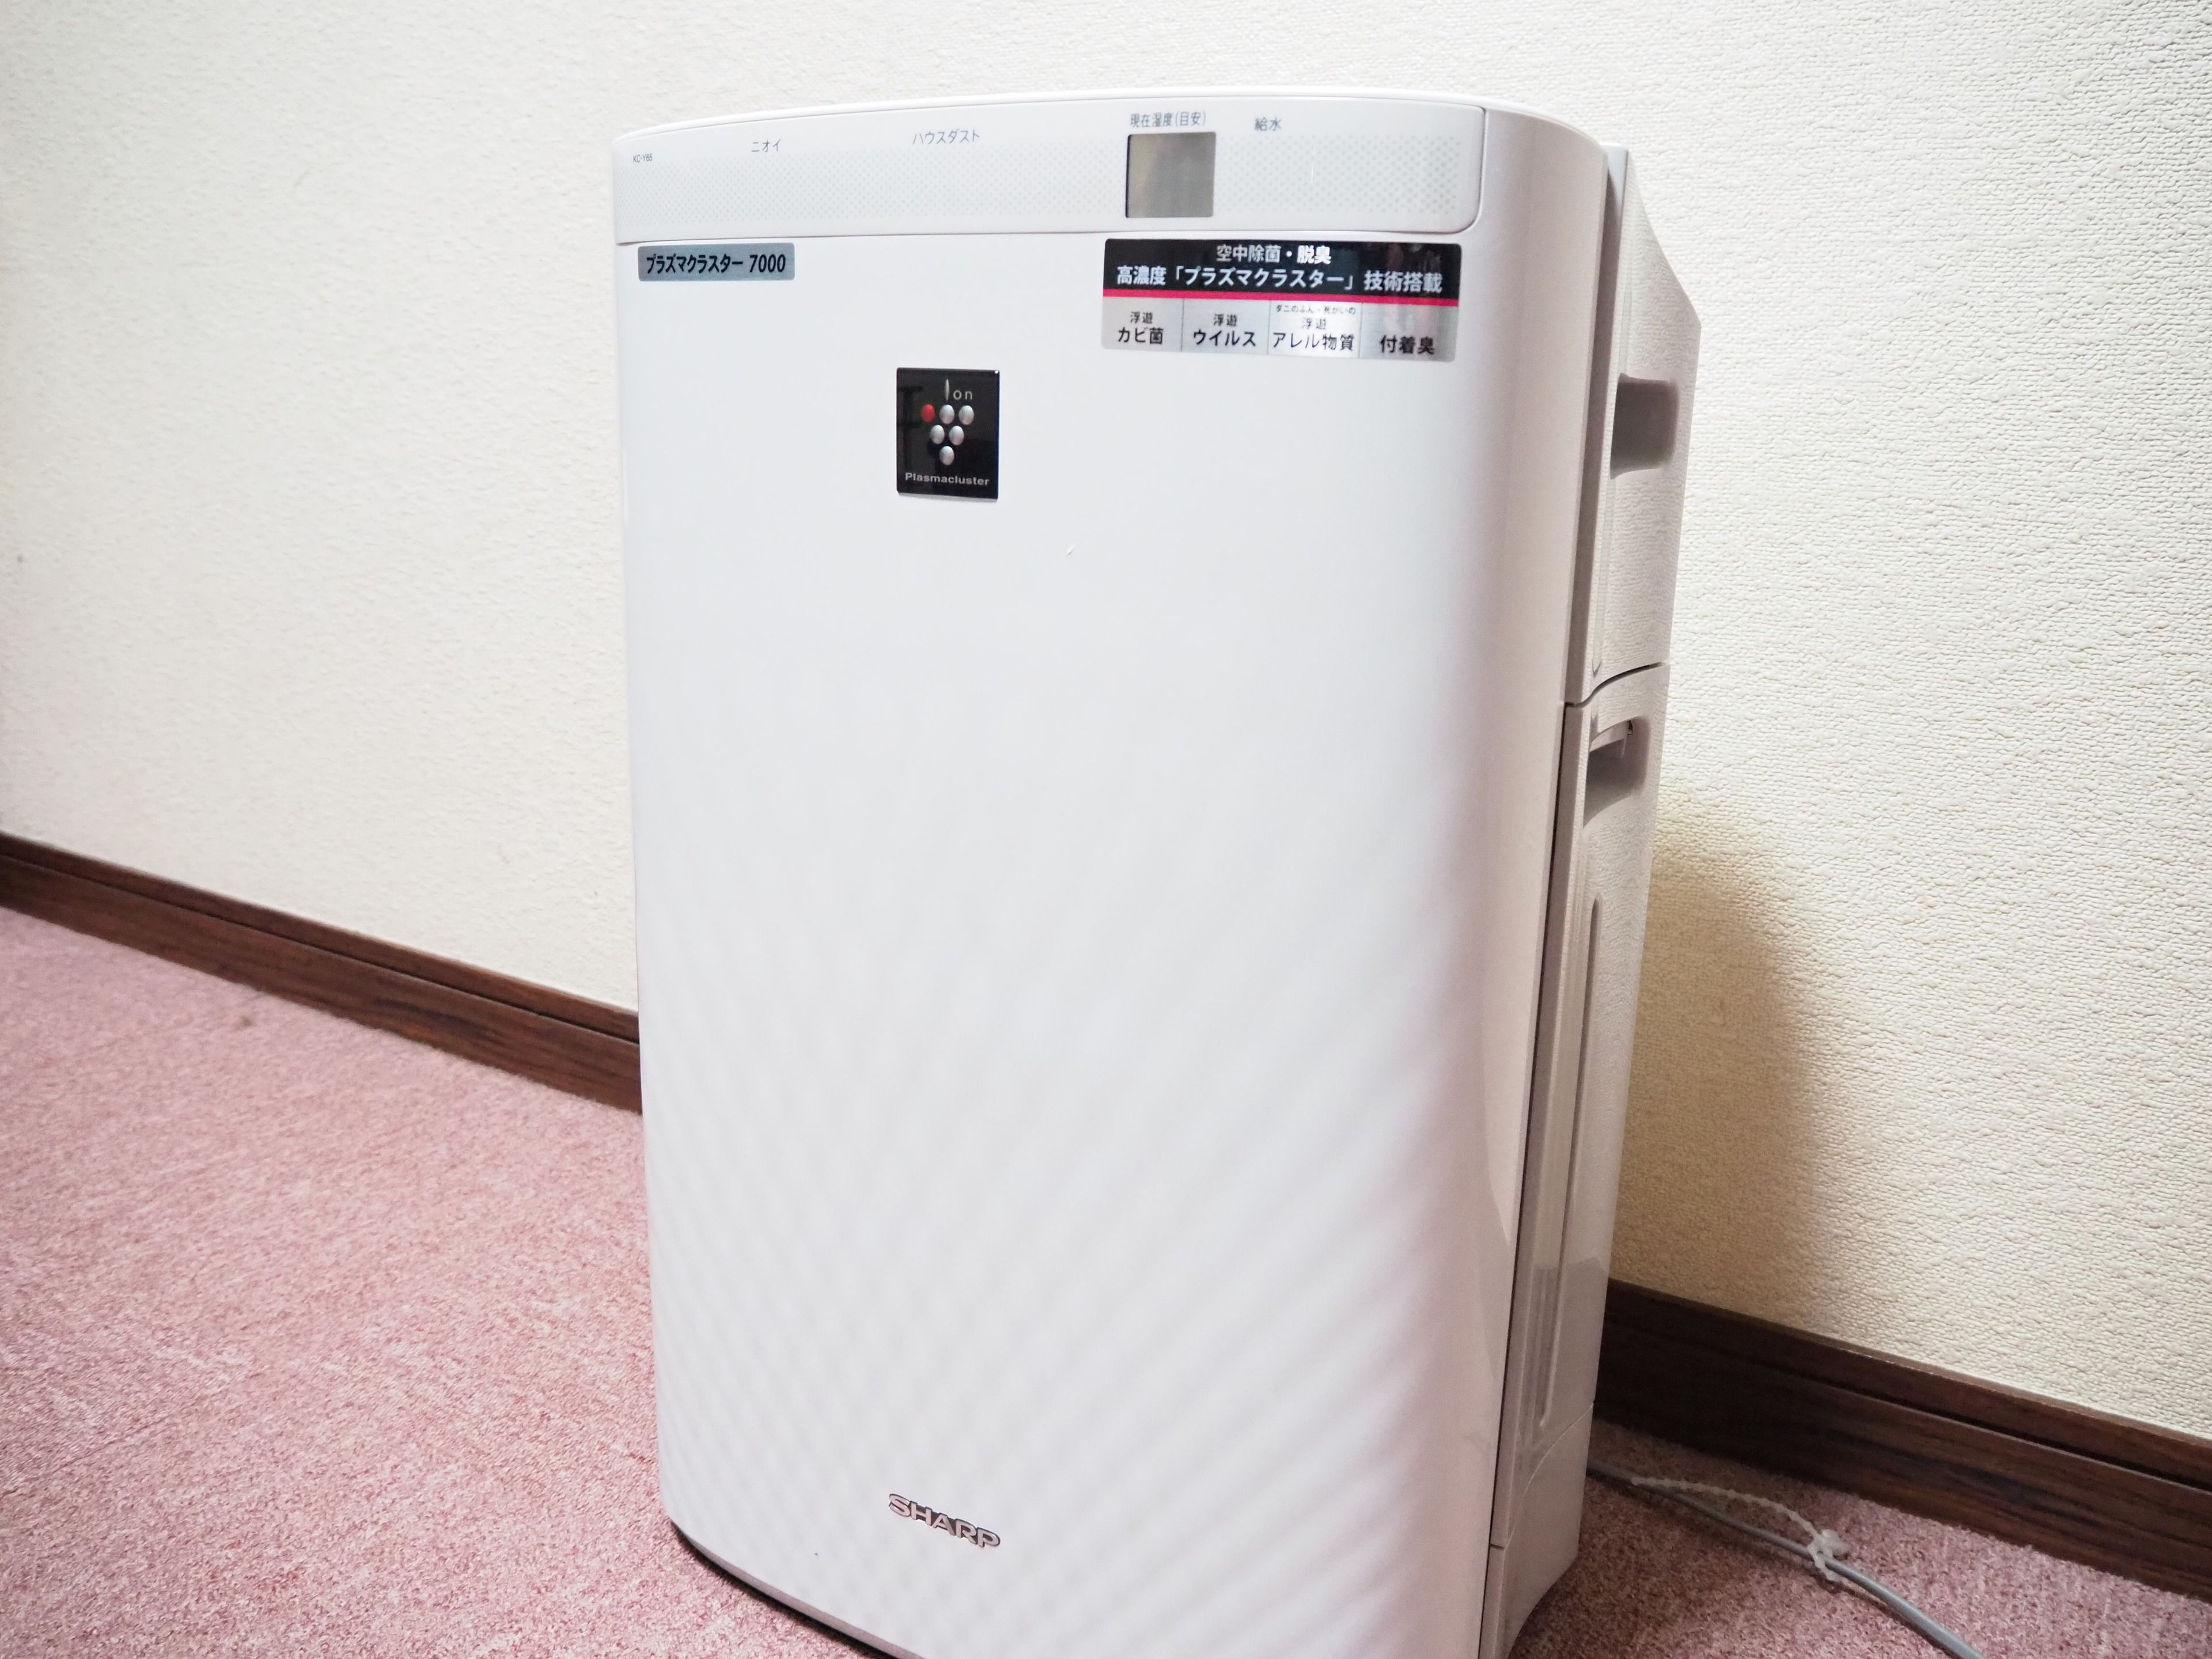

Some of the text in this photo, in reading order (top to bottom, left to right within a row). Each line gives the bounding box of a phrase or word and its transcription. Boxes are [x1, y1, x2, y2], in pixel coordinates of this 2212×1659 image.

[1255, 116, 1282, 131] 給水
[751, 139, 781, 152] ニオイ
[913, 128, 979, 145] ハウスダスト
[633, 153, 653, 162] KC-Y65
[1217, 244, 1331, 264] 空中除菌・脱臭
[646, 253, 786, 274] プラズマクラスター 7000
[1130, 311, 1153, 324] 浮遊
[1214, 313, 1238, 327] 浮遊
[1118, 327, 1164, 345] カビ菌
[1193, 329, 1256, 347] ウイルス
[1274, 332, 1354, 351] アレル物質
[1380, 335, 1435, 355] 付着臭
[945, 378, 972, 401] Ion
[905, 472, 990, 486] Plasmacluster
[888, 1493, 1001, 1547] SHARP
